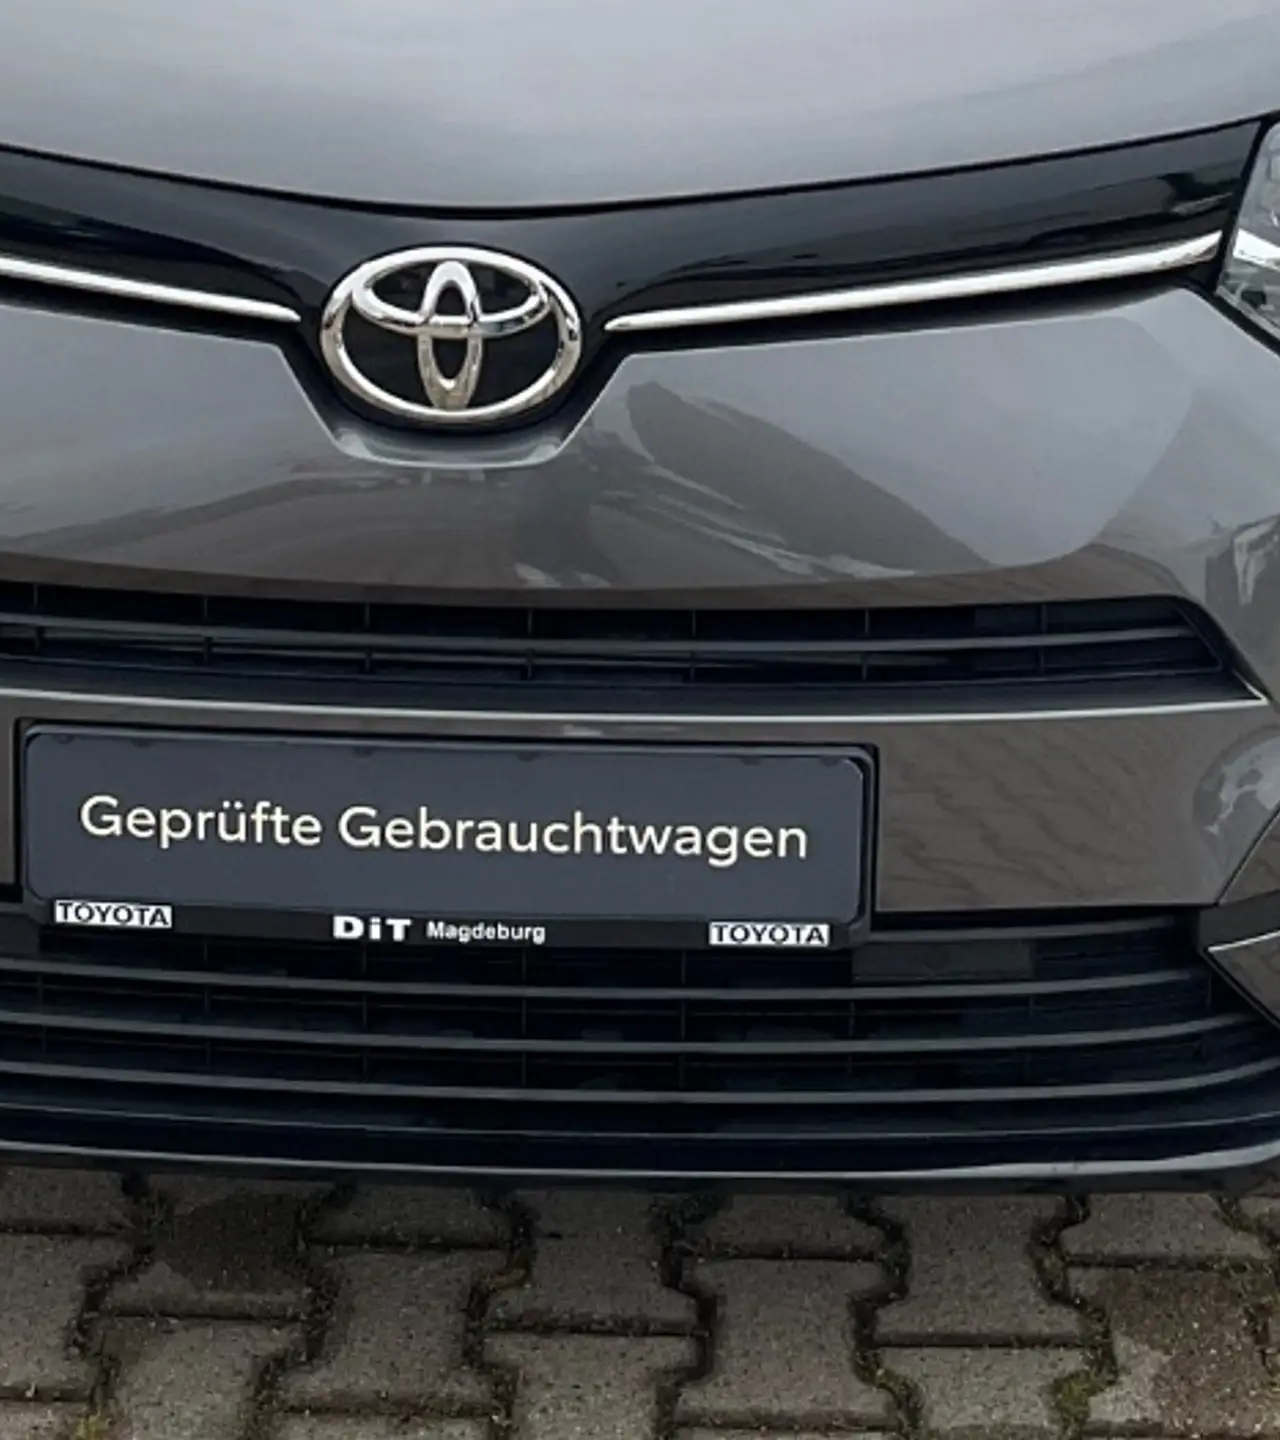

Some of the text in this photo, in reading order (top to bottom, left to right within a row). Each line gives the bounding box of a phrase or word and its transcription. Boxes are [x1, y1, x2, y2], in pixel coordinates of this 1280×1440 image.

[80, 795, 808, 868] Geprüfte Gebrauchtwagen
[58, 902, 170, 927] TOYOTA
[332, 915, 546, 945] DiT Magdeburg
[711, 924, 826, 945] TOYOTA
